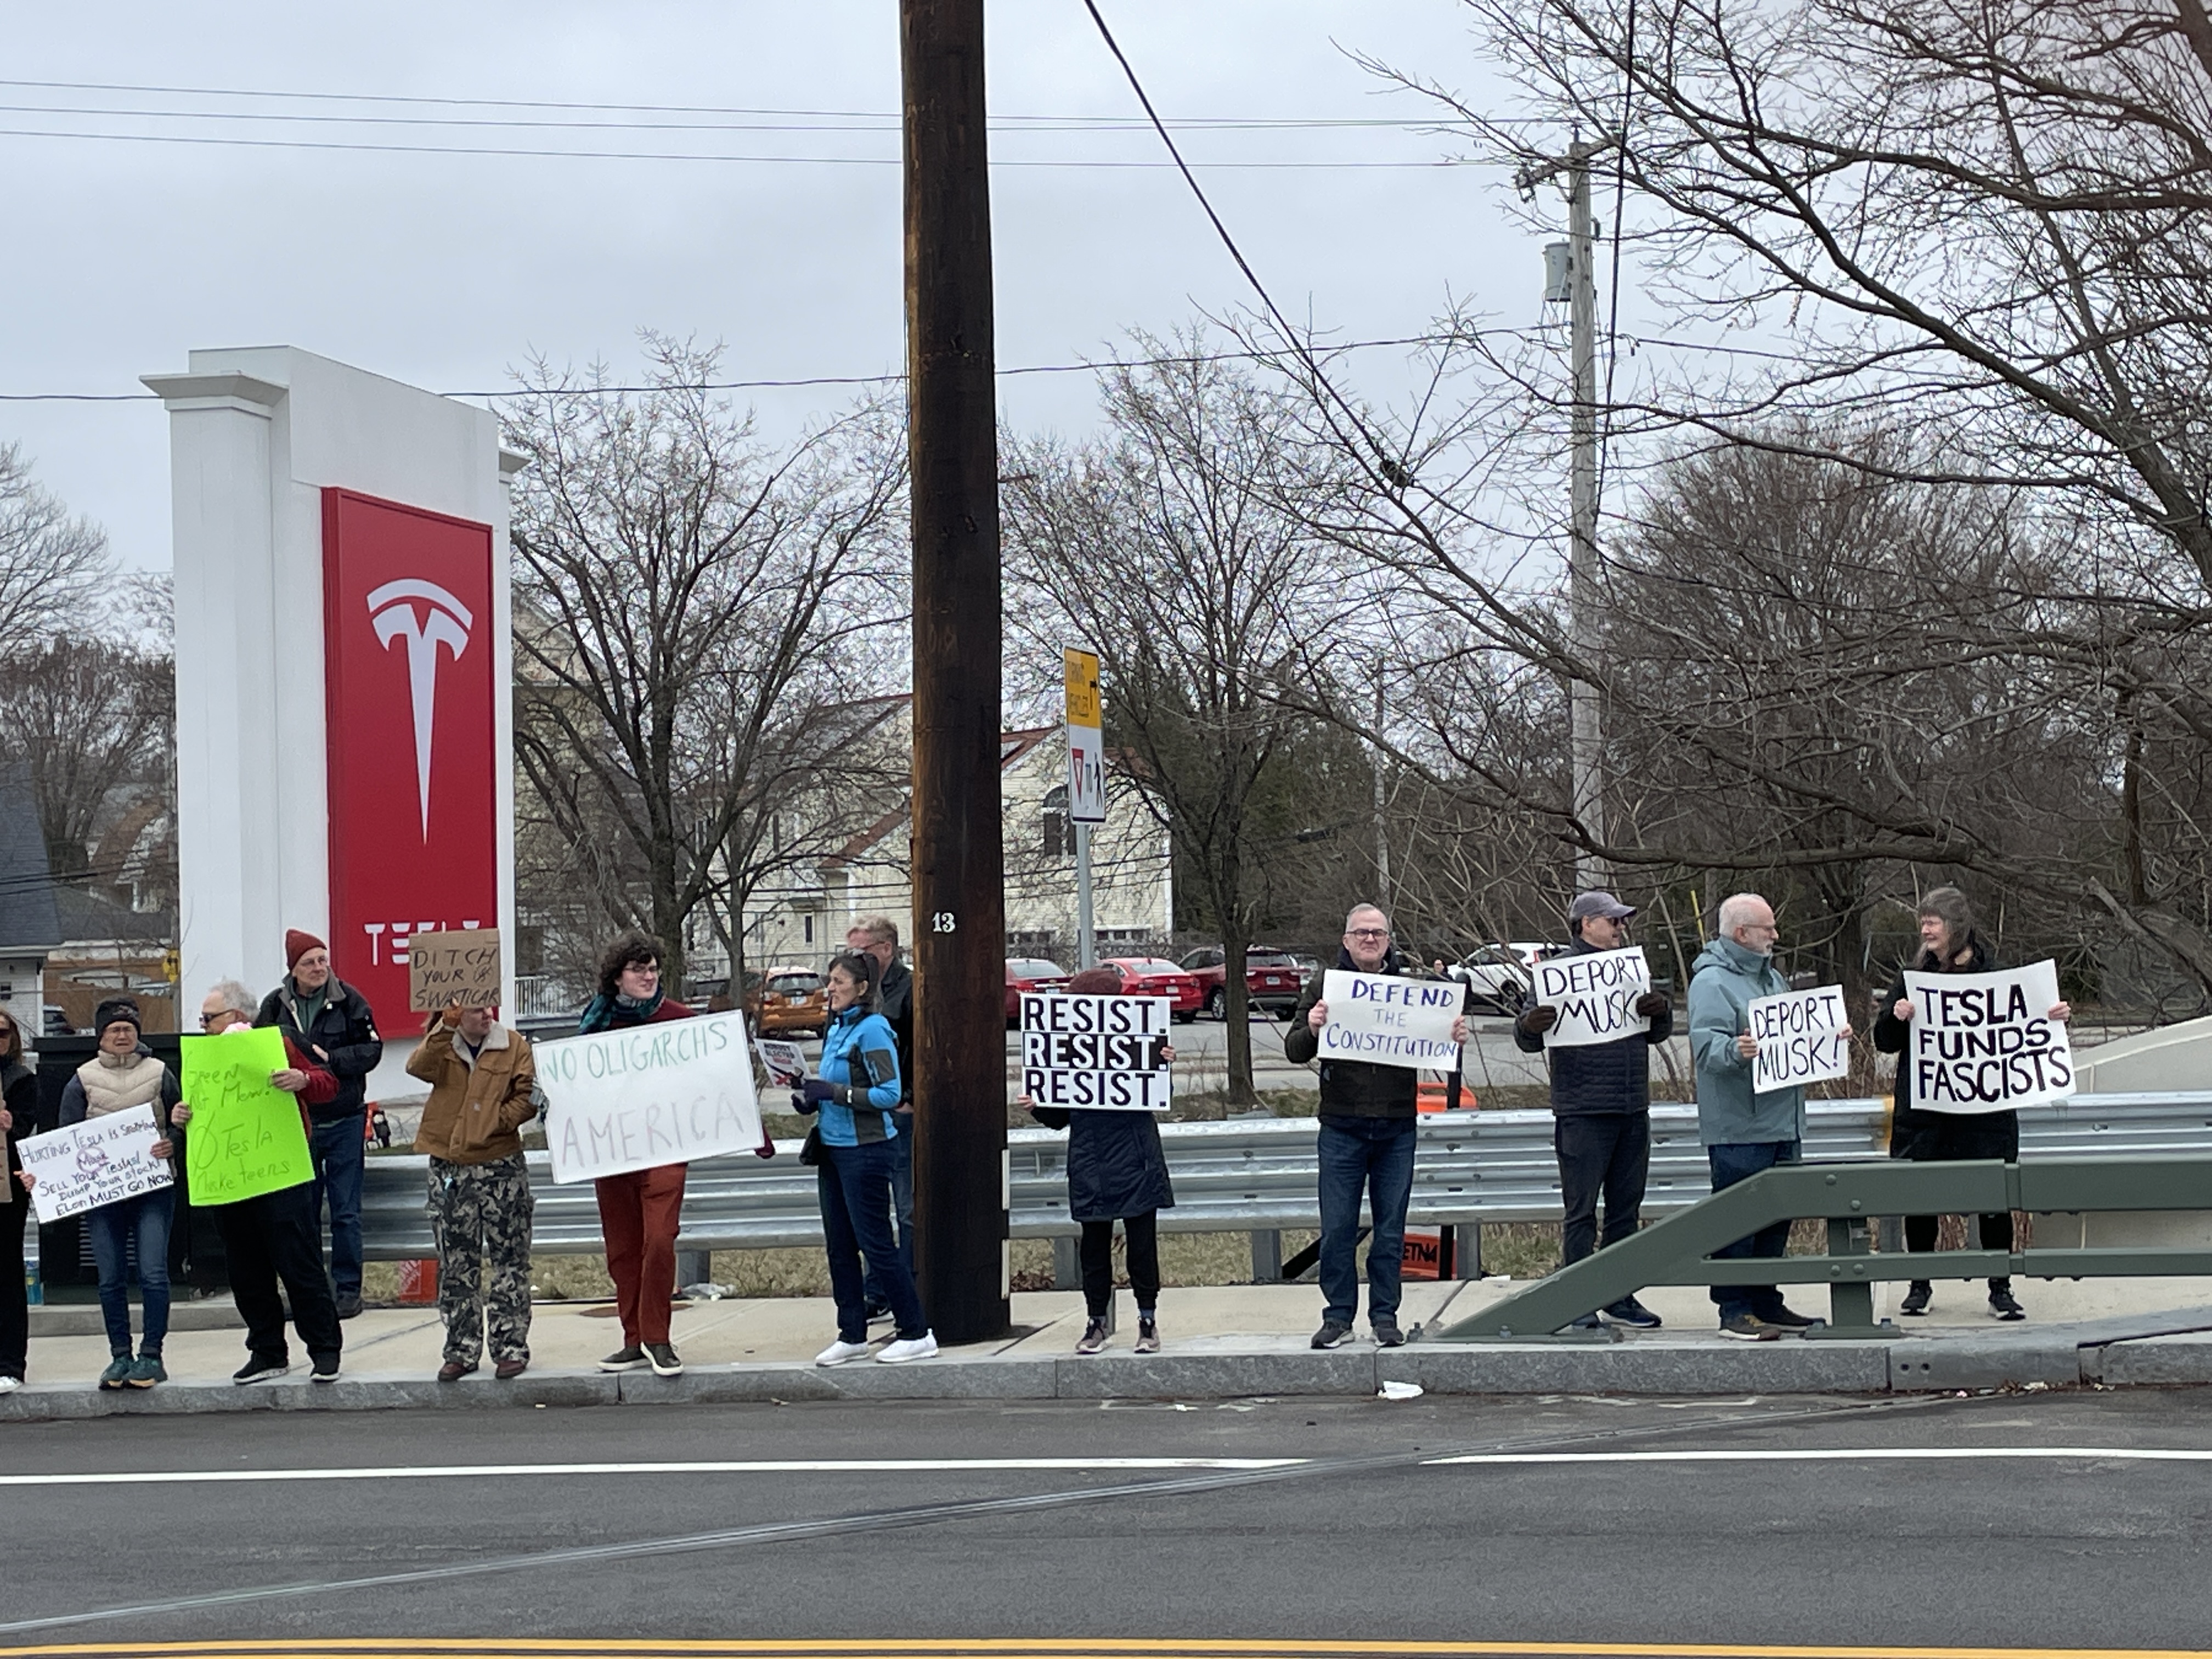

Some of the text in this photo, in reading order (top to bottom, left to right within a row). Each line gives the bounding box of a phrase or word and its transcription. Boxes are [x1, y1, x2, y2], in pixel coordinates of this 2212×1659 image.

[932, 912, 956, 933] 13
[414, 948, 497, 969] DITCH
[422, 968, 464, 985] YOUR
[1542, 955, 1642, 997] DEPORT
[1351, 979, 1454, 1007] DEFEND
[1916, 984, 2028, 1027] TESLA
[1024, 997, 1167, 1034] RESIST.
[1373, 1008, 1408, 1028] THE
[1553, 988, 1647, 1036] MUSK
[1754, 995, 1837, 1041] DEPORT
[541, 1021, 728, 1083] NO OLIGARCHS
[1024, 1033, 1167, 1070] RESIST.
[1326, 1023, 1459, 1058] CONSTITUTION
[1919, 1018, 2051, 1060] FUNDS
[1757, 1033, 1840, 1086] MUSK!
[1918, 1046, 2071, 1103] FASCISTS
[1025, 1070, 1167, 1107] RESIST.
[562, 1093, 744, 1168] AMERICA
[88, 1184, 126, 1206] MUST
[127, 1180, 145, 1193] GO
